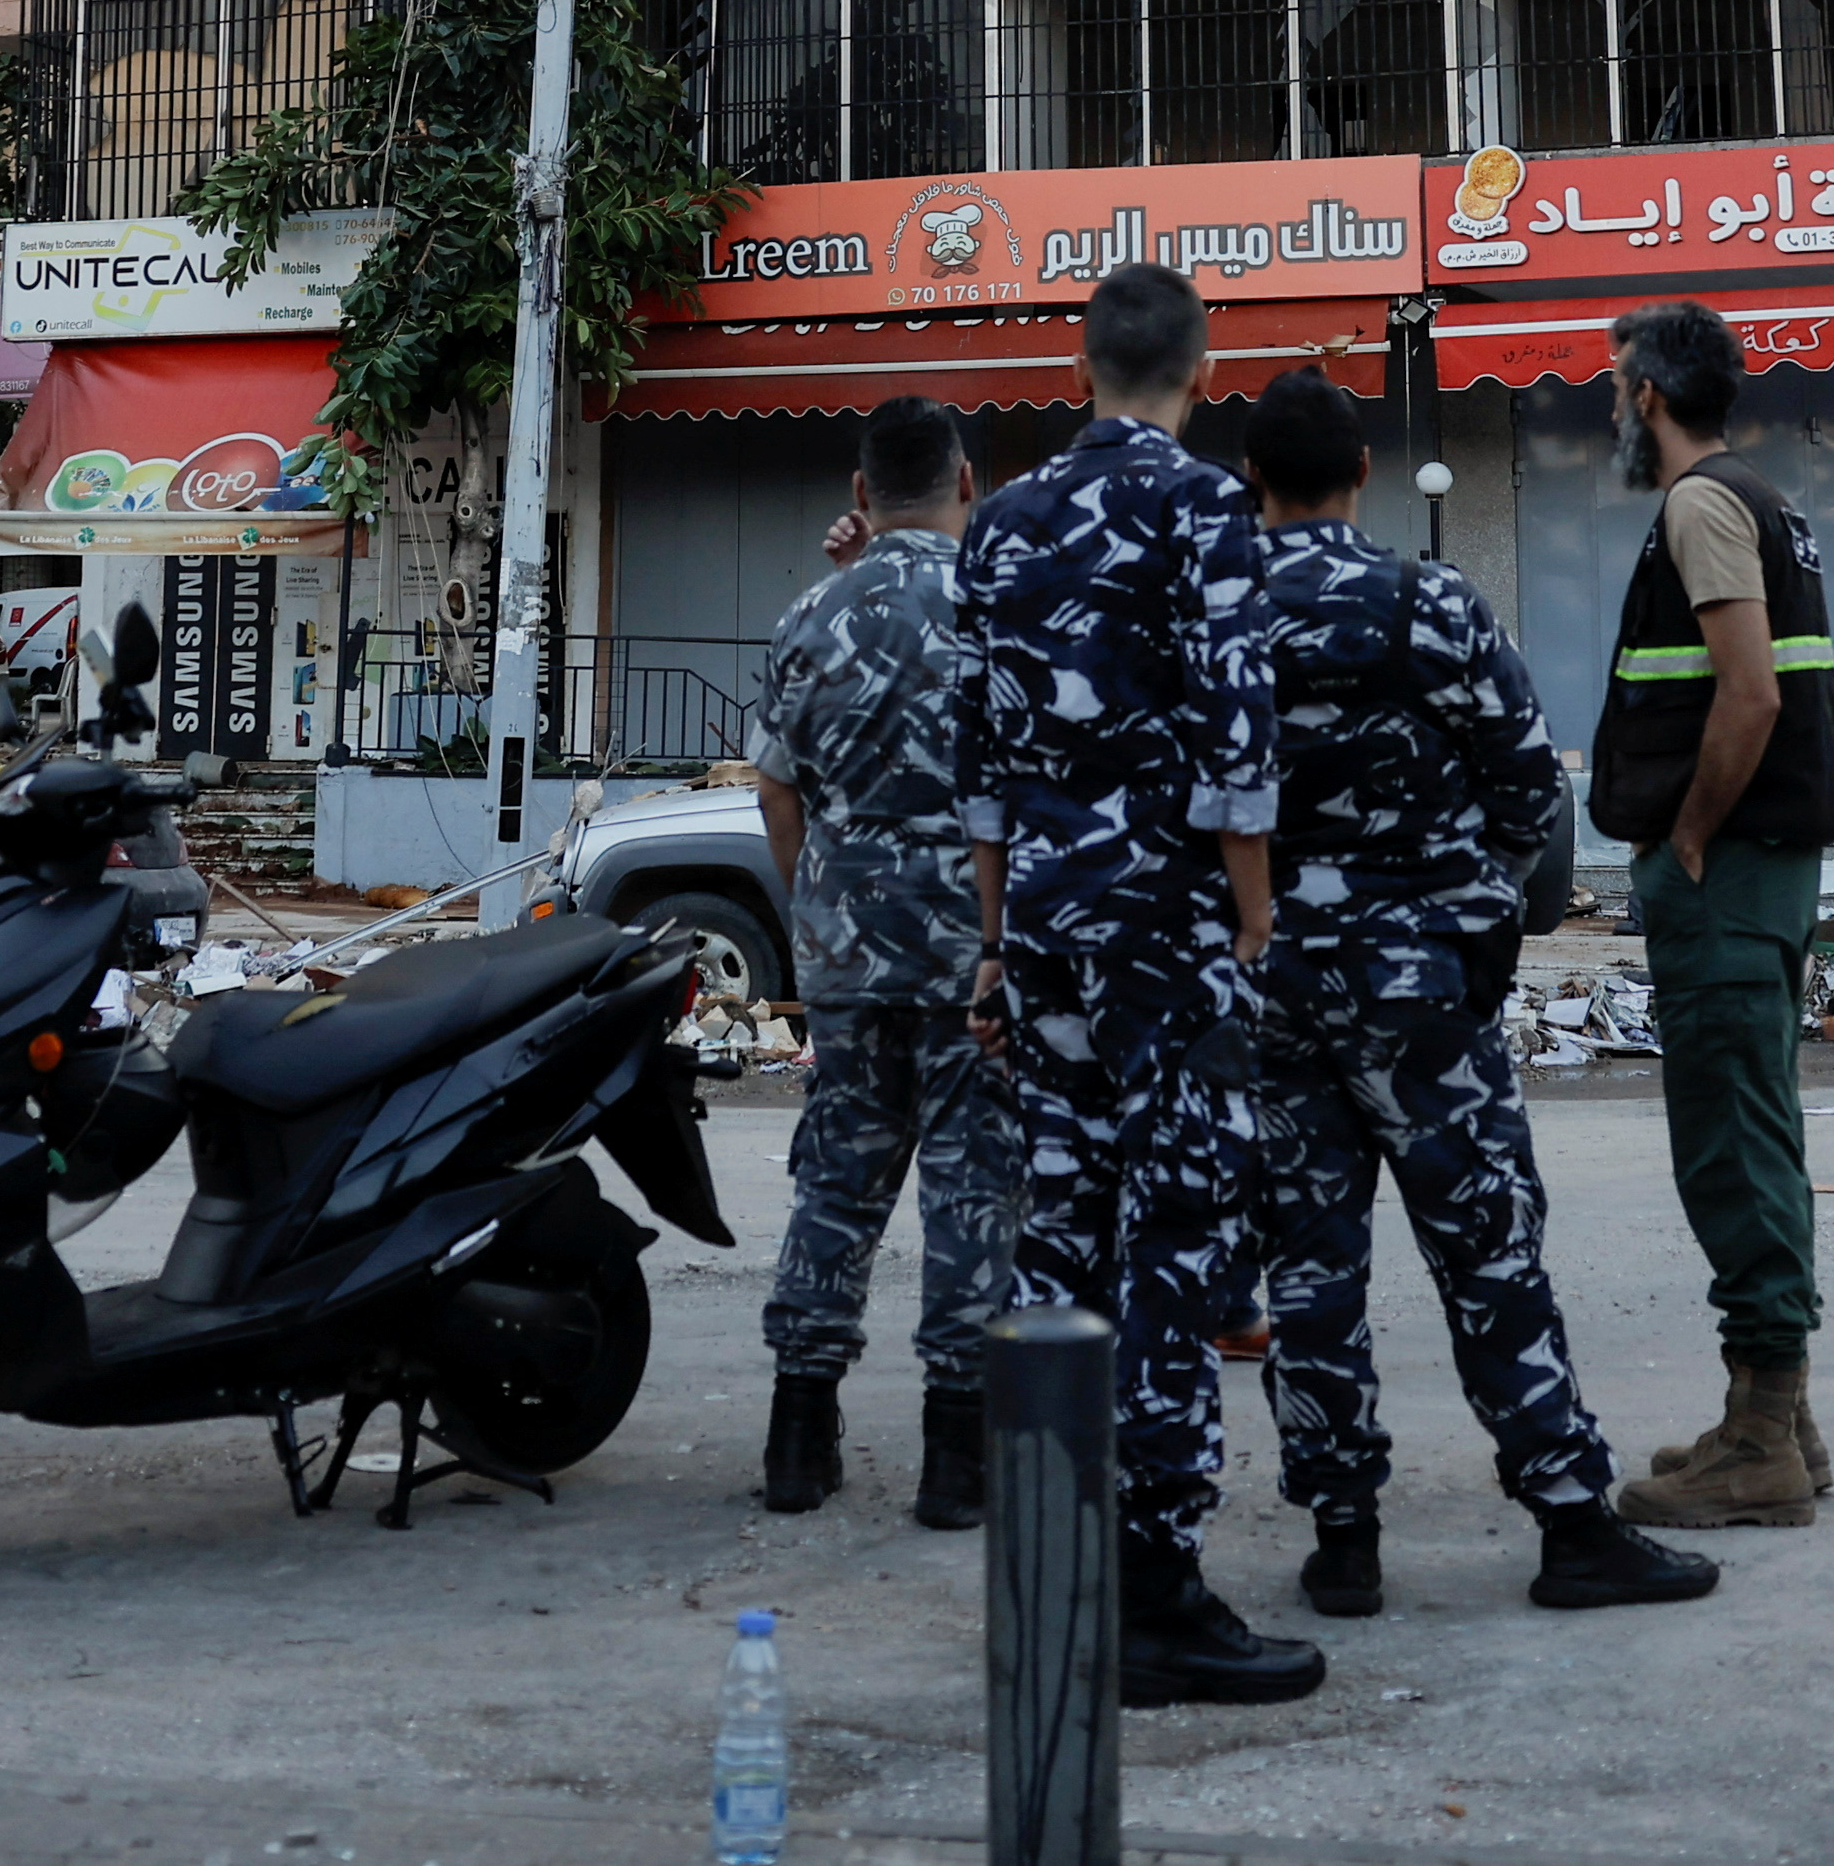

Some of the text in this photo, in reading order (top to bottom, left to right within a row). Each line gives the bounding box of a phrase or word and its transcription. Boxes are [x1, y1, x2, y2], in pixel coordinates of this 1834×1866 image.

[982, 193, 1010, 226] حمص
[1708, 155, 1794, 242] أبو
[1484, 219, 1503, 231] جملة
[20, 238, 116, 252] Best Way to Communicate
[884, 211, 909, 274] معجنات
[1006, 228, 1023, 268] فول
[1040, 202, 1404, 281] سناك ميس الريم
[16, 253, 249, 291] UNITECAL
[281, 262, 321, 275] Mobiles
[910, 282, 1023, 304] 70 176 171
[264, 306, 313, 321] Recharge
[49, 319, 93, 331] unitecall
[1740, 318, 1831, 354] كعكة
[183, 535, 300, 545] La Libanaise des Jeux
[415, 575, 438, 583] Saring
